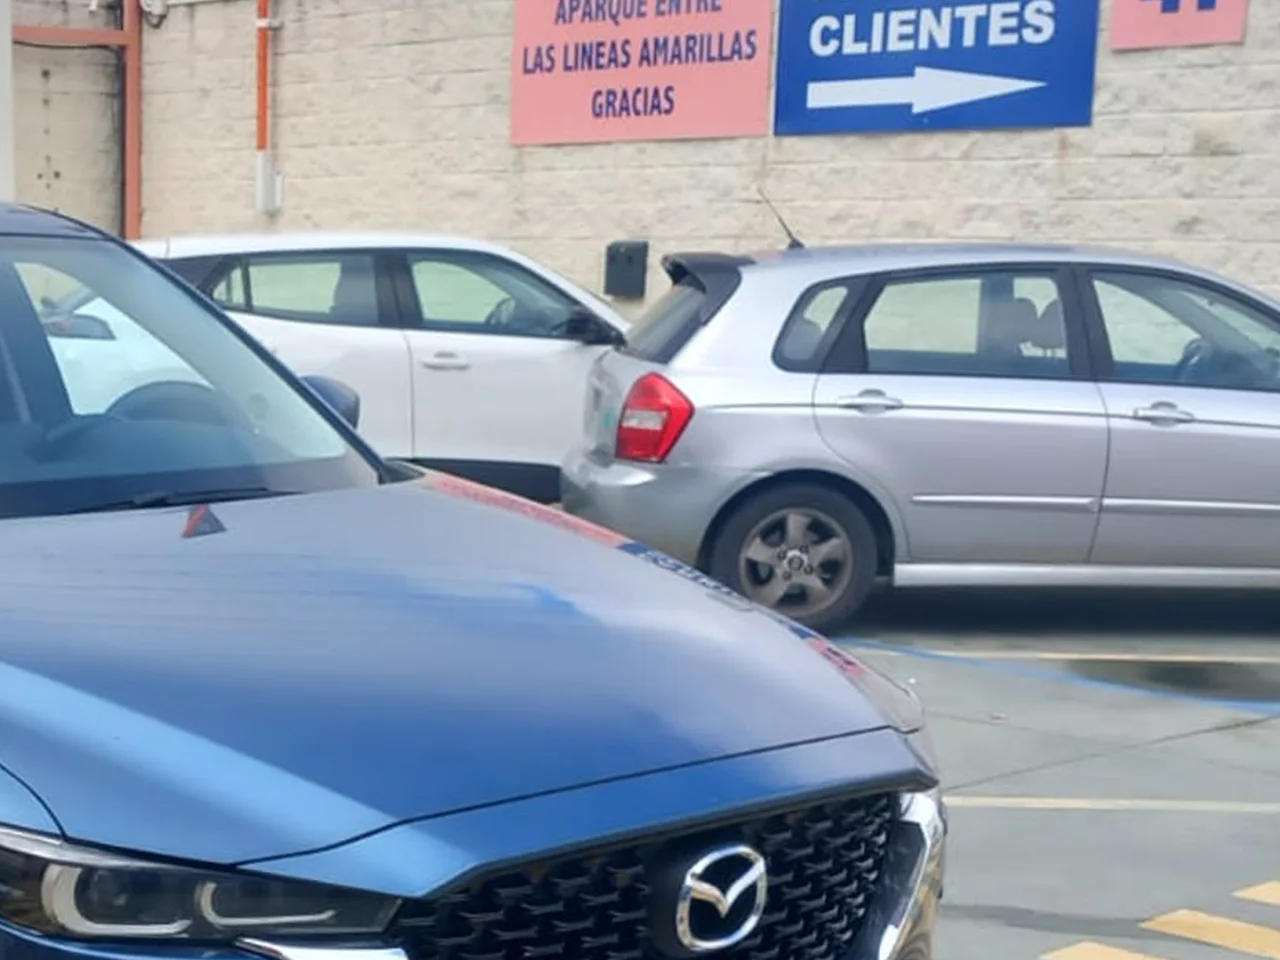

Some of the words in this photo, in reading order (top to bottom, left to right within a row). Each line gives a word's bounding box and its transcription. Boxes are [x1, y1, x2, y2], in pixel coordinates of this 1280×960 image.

[555, 0, 647, 25] APARQUE
[809, 0, 1055, 56] CLIENTES
[523, 45, 555, 74] LAS
[563, 39, 631, 72] LINEAS
[638, 30, 757, 68] AMARILLAS
[591, 86, 675, 118] GRACIAS
